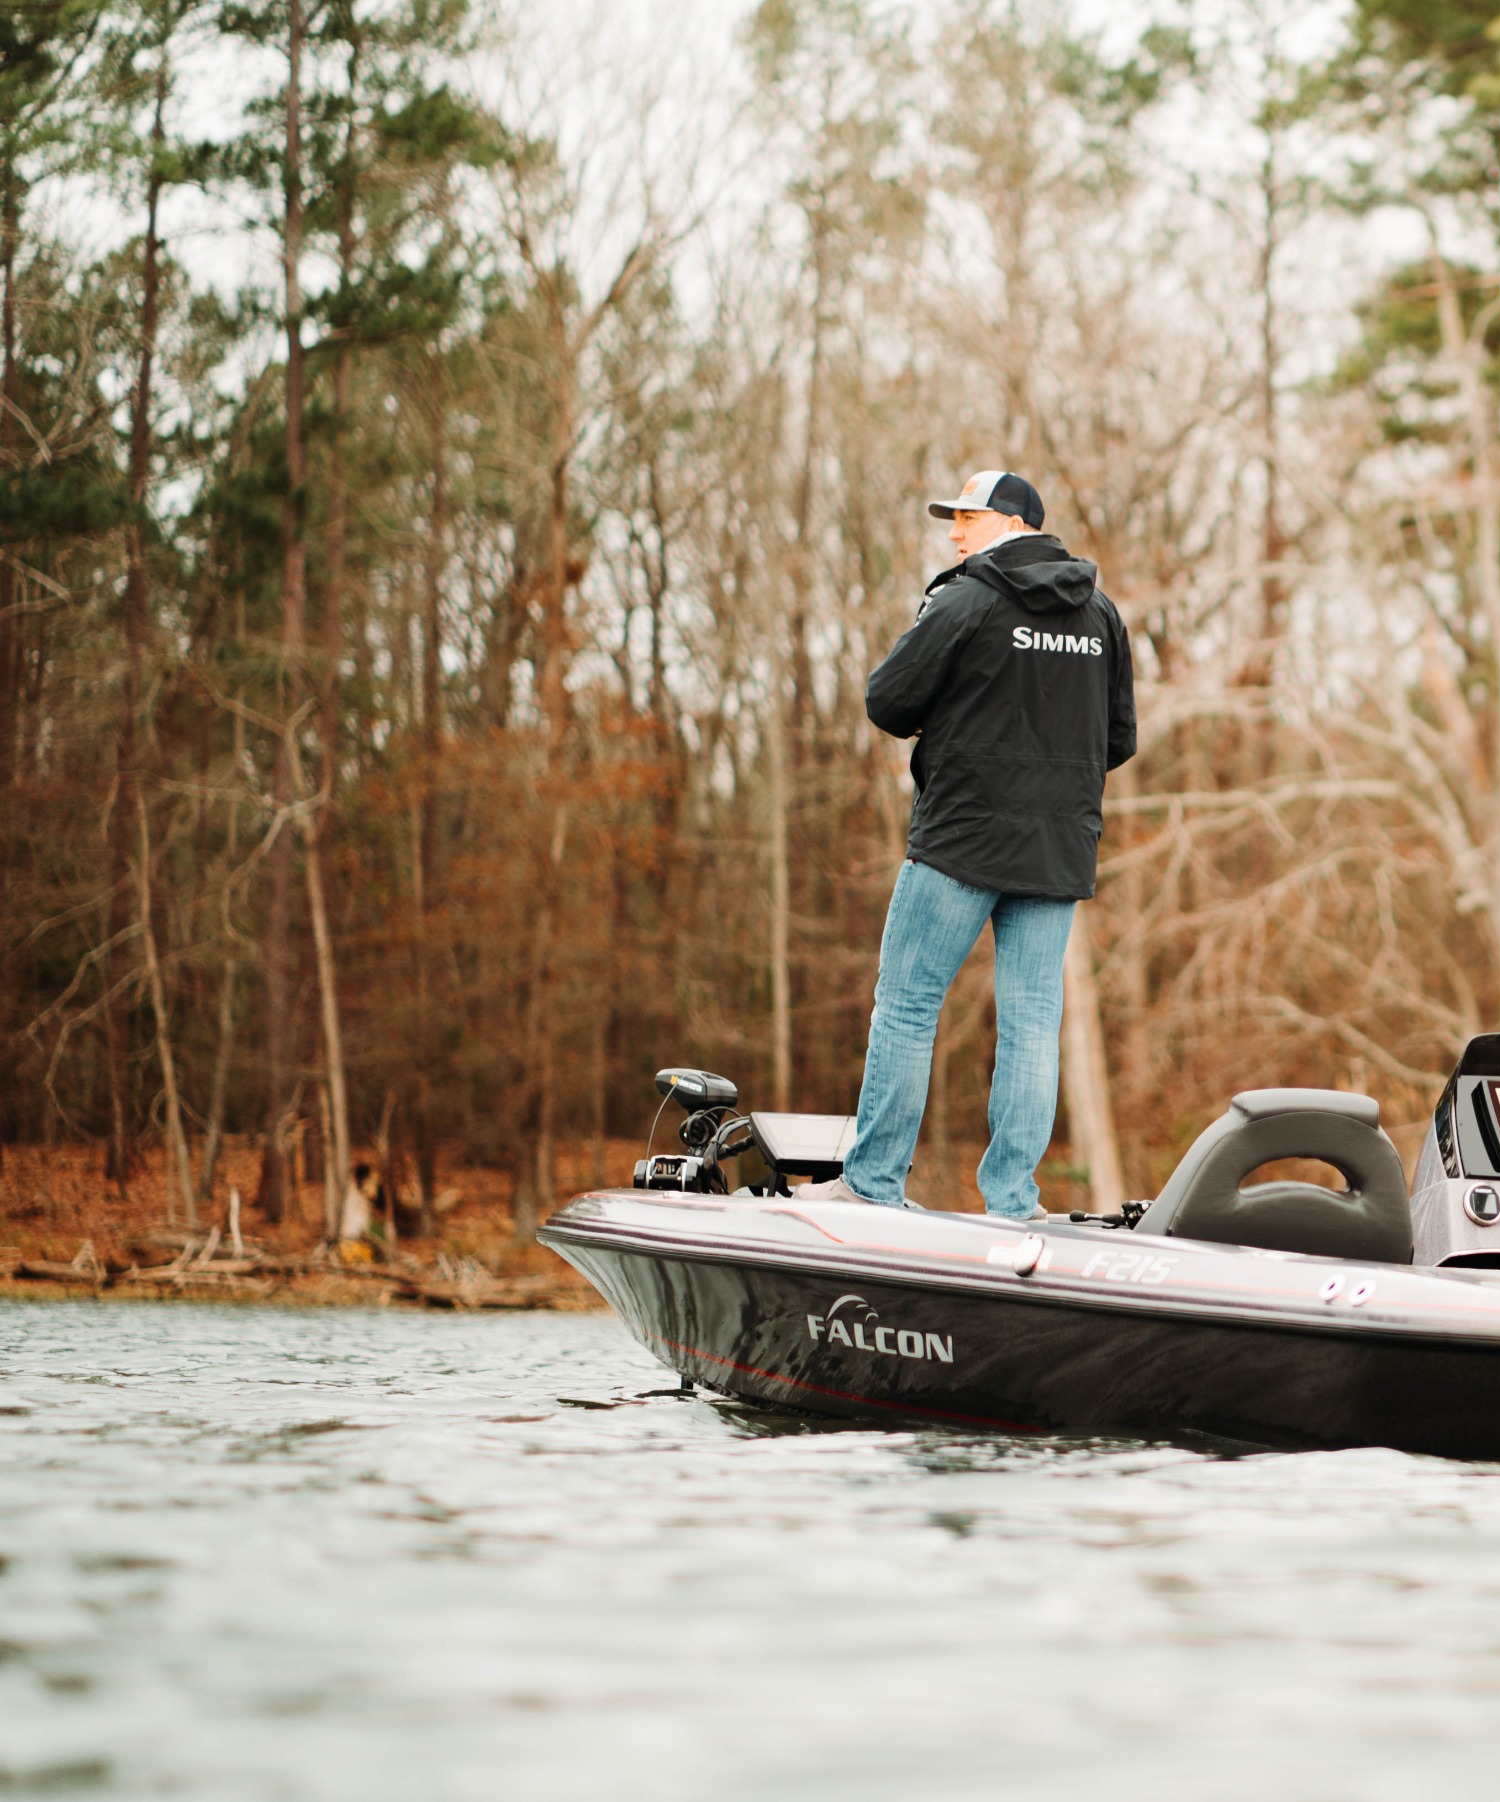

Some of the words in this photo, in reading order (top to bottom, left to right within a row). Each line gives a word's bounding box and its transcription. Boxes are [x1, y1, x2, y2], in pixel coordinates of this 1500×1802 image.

[1012, 626, 1103, 656] SIMMS
[1080, 1250, 1181, 1285] F215
[806, 1314, 954, 1363] FALCON
